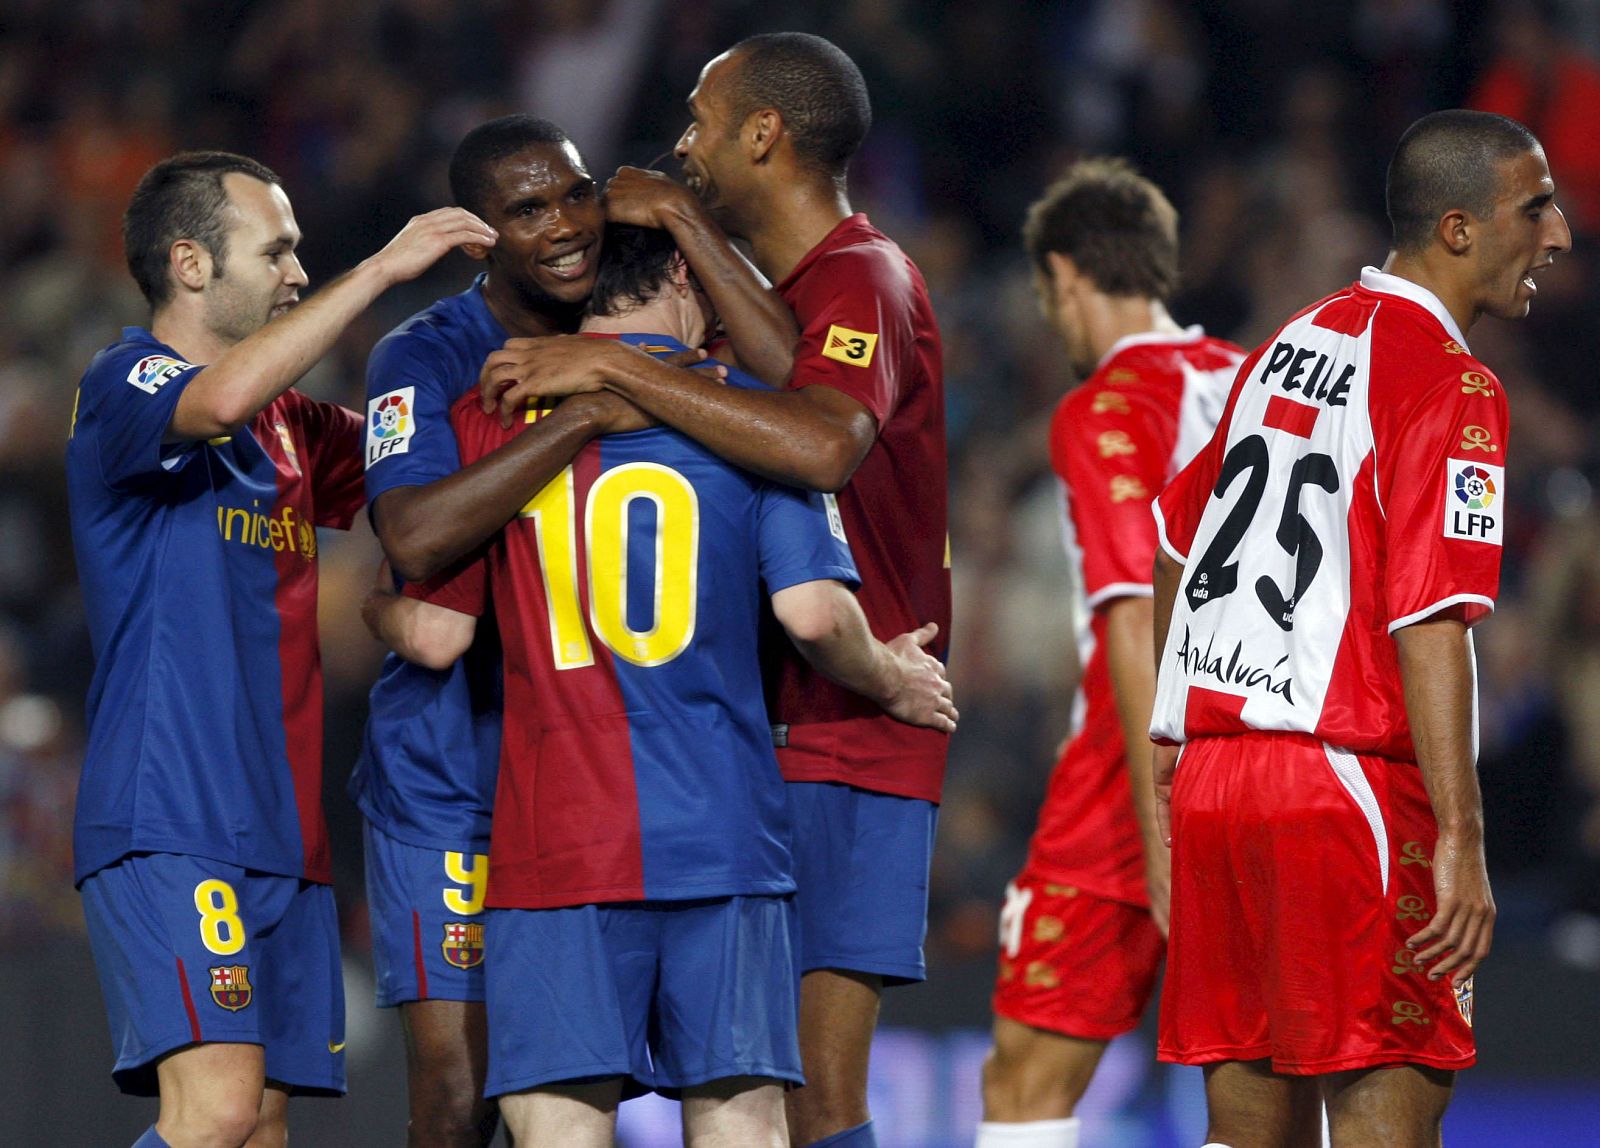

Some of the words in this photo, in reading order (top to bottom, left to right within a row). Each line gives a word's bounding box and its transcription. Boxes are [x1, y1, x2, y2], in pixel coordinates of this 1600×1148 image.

[846, 338, 867, 359] 3
[369, 437, 405, 465] LFP
[1184, 434, 1340, 632] 25
[1453, 510, 1495, 538] LFP
[517, 461, 700, 671] 10
[1192, 587, 1209, 600] uda
[1175, 622, 1295, 706] Andalucía
[443, 851, 488, 915] 9
[193, 878, 246, 956] 8
